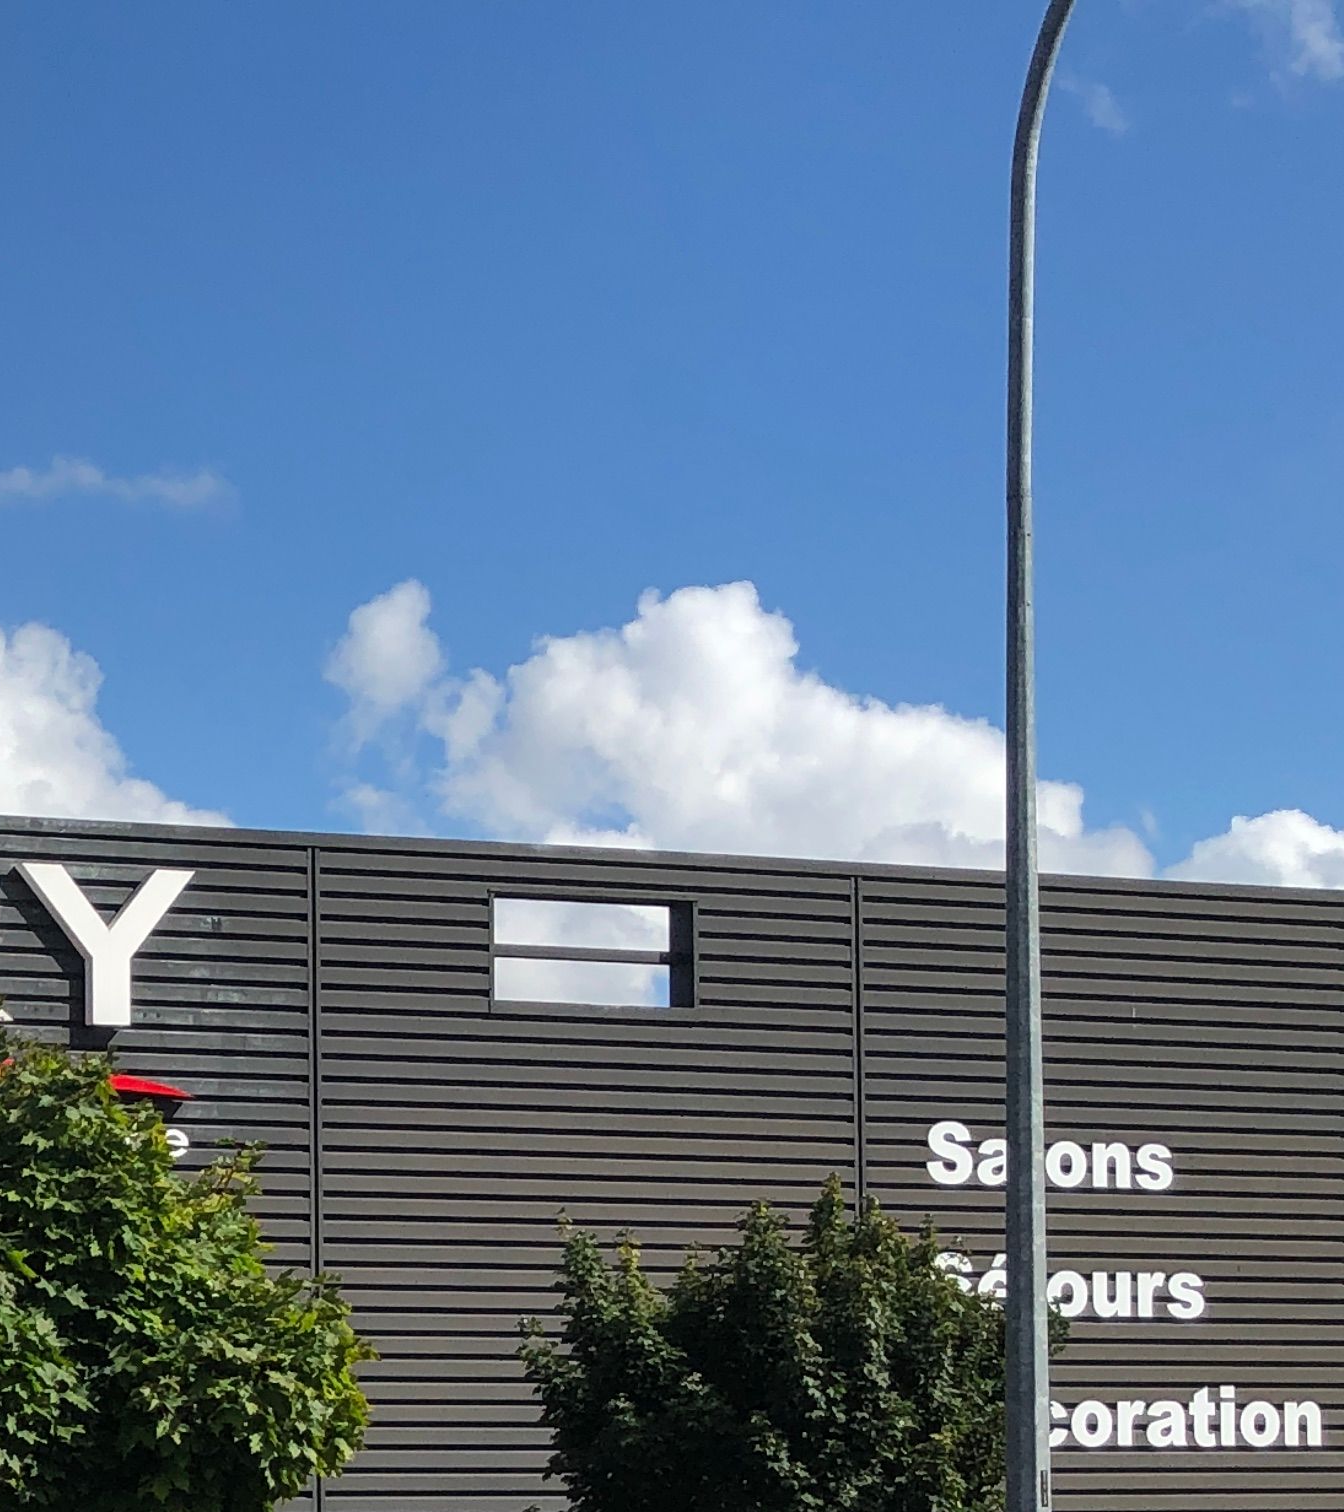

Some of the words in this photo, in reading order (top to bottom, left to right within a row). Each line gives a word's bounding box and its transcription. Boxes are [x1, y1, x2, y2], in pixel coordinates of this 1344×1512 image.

[926, 1120, 1174, 1191] Saons
[933, 1252, 1206, 1319] Séours
[1049, 1385, 1323, 1448] coration
